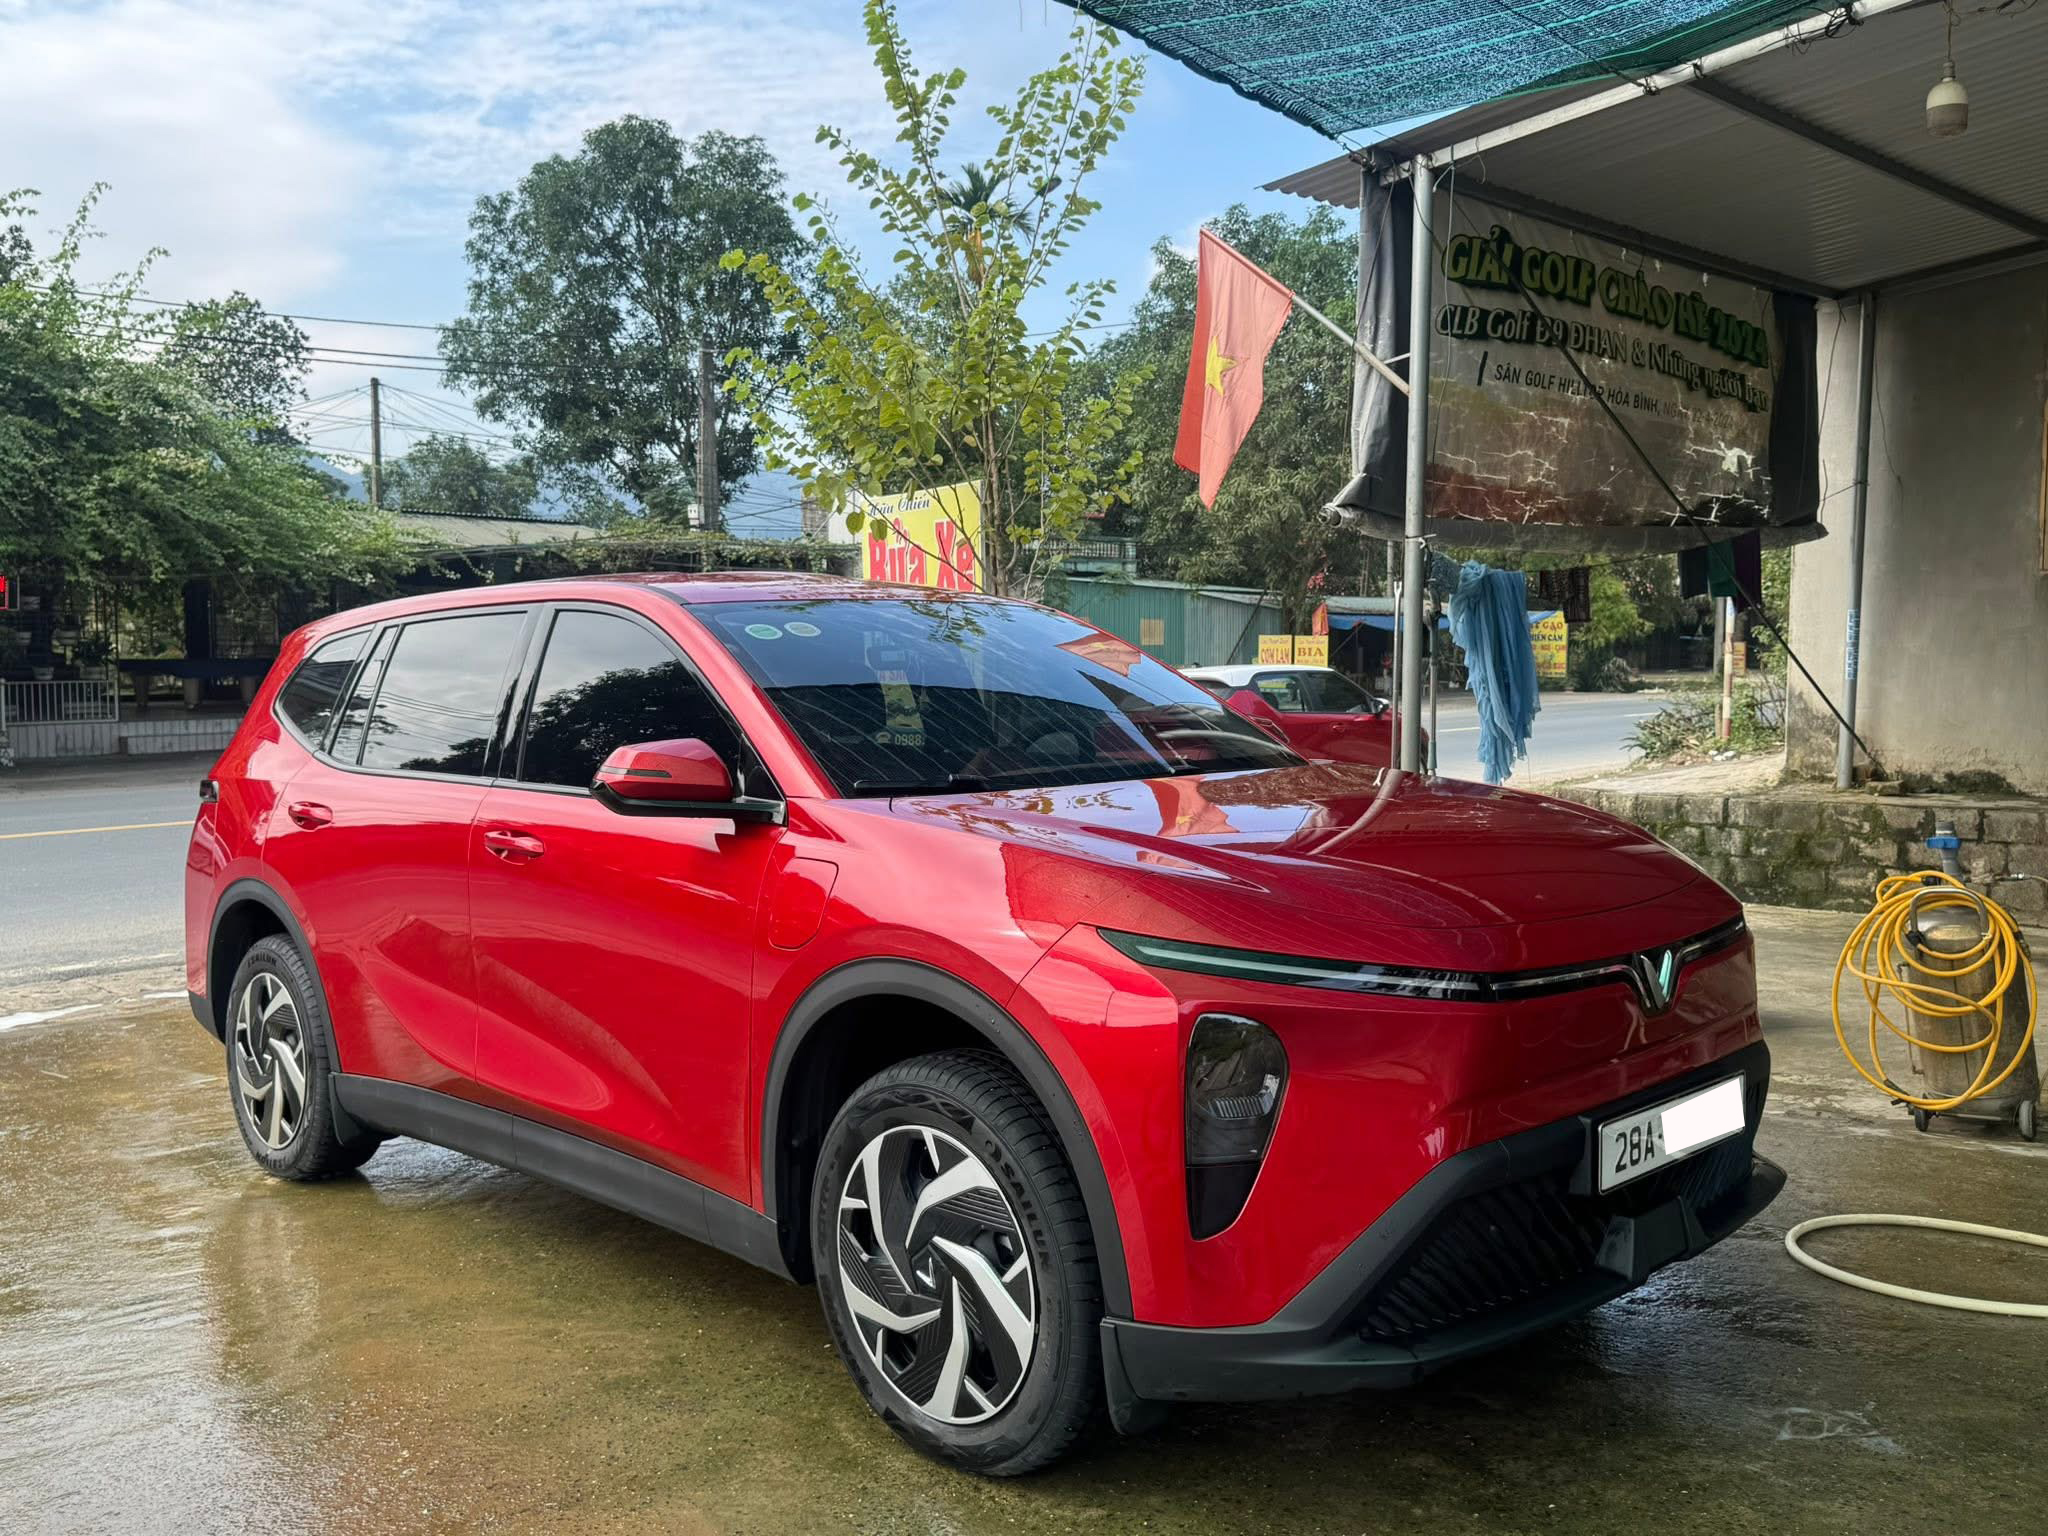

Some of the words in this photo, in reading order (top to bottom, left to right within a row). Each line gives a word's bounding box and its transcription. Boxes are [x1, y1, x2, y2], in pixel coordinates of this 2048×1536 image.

[1520, 246, 1596, 305] GOLF
[1598, 266, 1675, 328] CHÀO
[1436, 304, 1481, 336] CLB
[1486, 308, 1533, 343] Golf
[1632, 337, 1647, 367] &
[1649, 342, 1701, 391] Những
[1525, 370, 1555, 390] GOLF
[868, 517, 927, 585] Rửa
[1297, 647, 1324, 658] BIA
[1000, 1162, 1052, 1272] SAILUN
